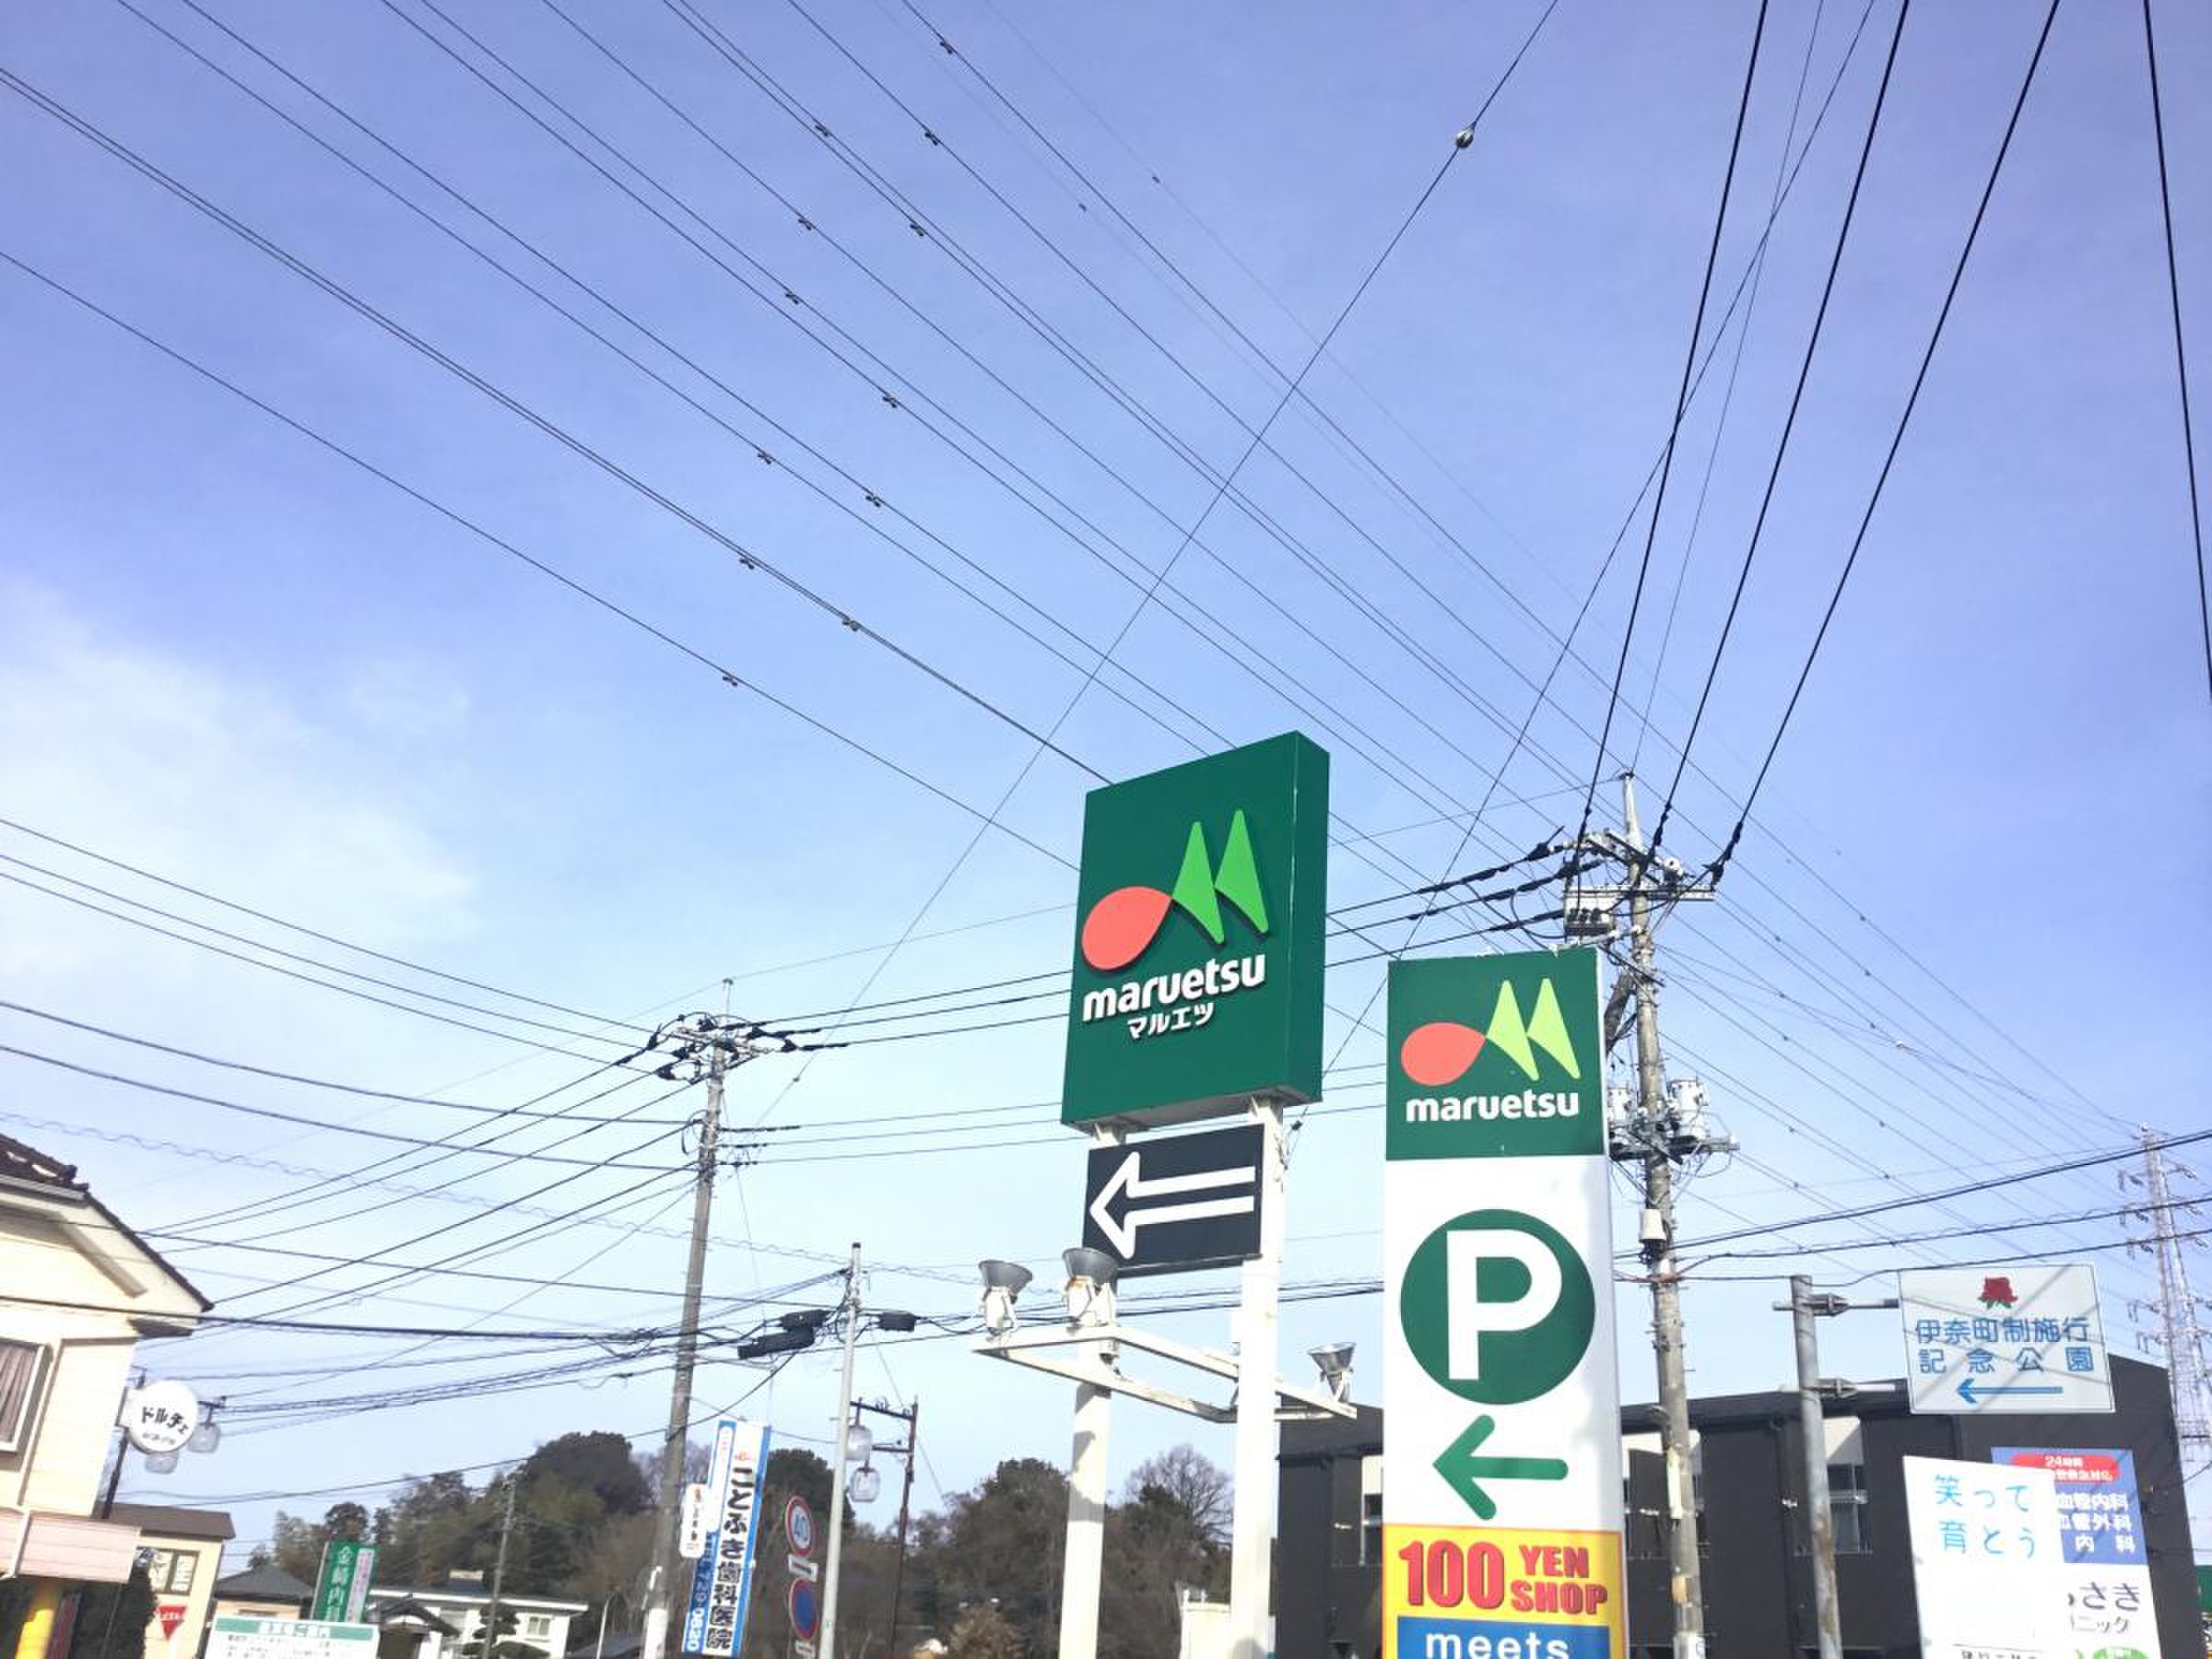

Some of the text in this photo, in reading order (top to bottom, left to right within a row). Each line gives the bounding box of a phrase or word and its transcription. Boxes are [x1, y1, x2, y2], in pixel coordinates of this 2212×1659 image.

[1082, 953, 1266, 1022] maruetsu
[1126, 1002, 1215, 1040] マルエツ
[1405, 1088, 1580, 1124] maruetsu
[1445, 1229, 1563, 1381] P
[1917, 1316, 2089, 1345] 伊奈町制施行
[1918, 1347, 2095, 1374] 記念公園
[141, 1406, 190, 1435] ドルチェ
[1935, 1475, 2030, 1512] 笑って
[705, 1466, 756, 1651] ことぶき歯科医院
[1938, 1521, 2036, 1559] 育とう
[1398, 1540, 1590, 1609] 100 YEN
[1511, 1580, 1608, 1615] SHOP
[1425, 1632, 1570, 1659] meets
